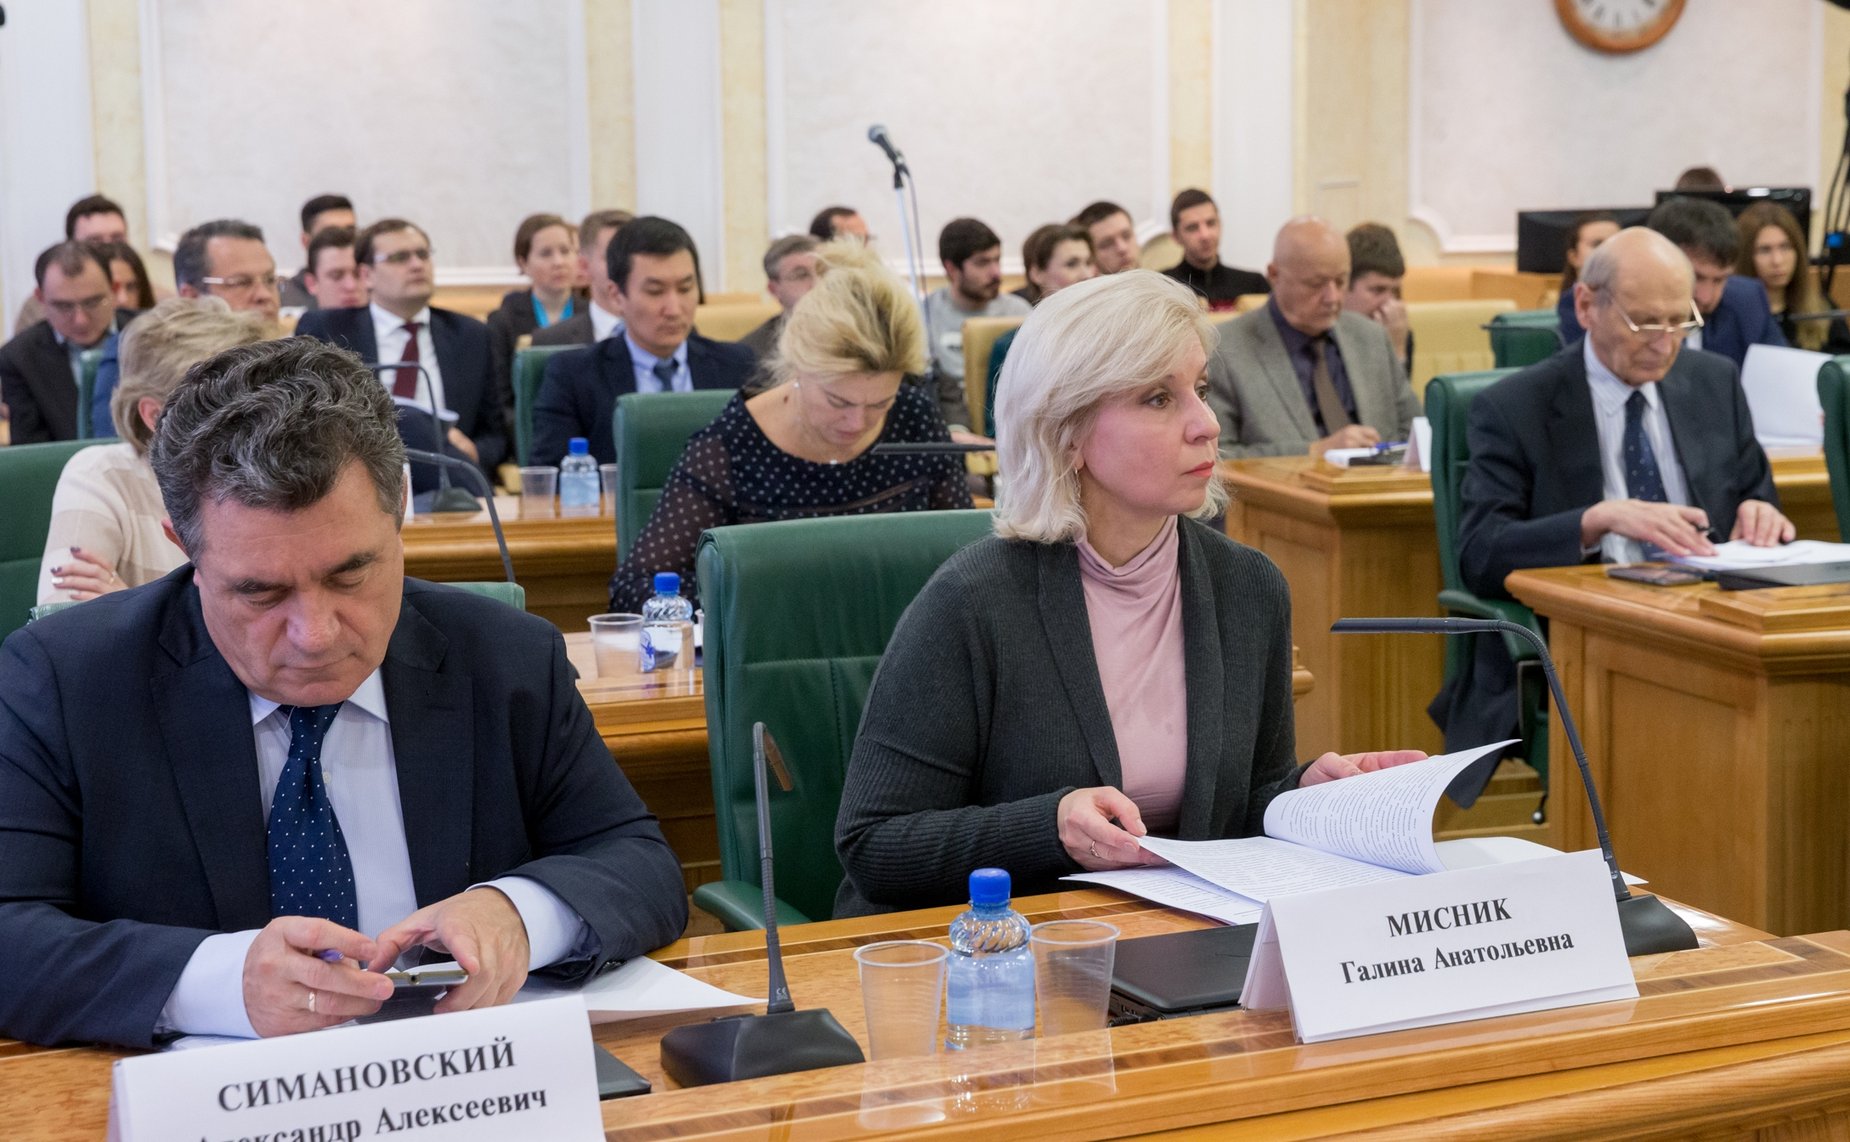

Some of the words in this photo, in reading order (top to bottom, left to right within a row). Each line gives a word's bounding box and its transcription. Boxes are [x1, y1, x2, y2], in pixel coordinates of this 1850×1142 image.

[1386, 898, 1512, 937] МИСНИК
[1340, 956, 1425, 984] Галина
[1434, 933, 1575, 969] Анатольевна
[217, 1037, 517, 1112] СИМАНОВСКИЙ
[375, 1089, 548, 1135] Алексеевич
